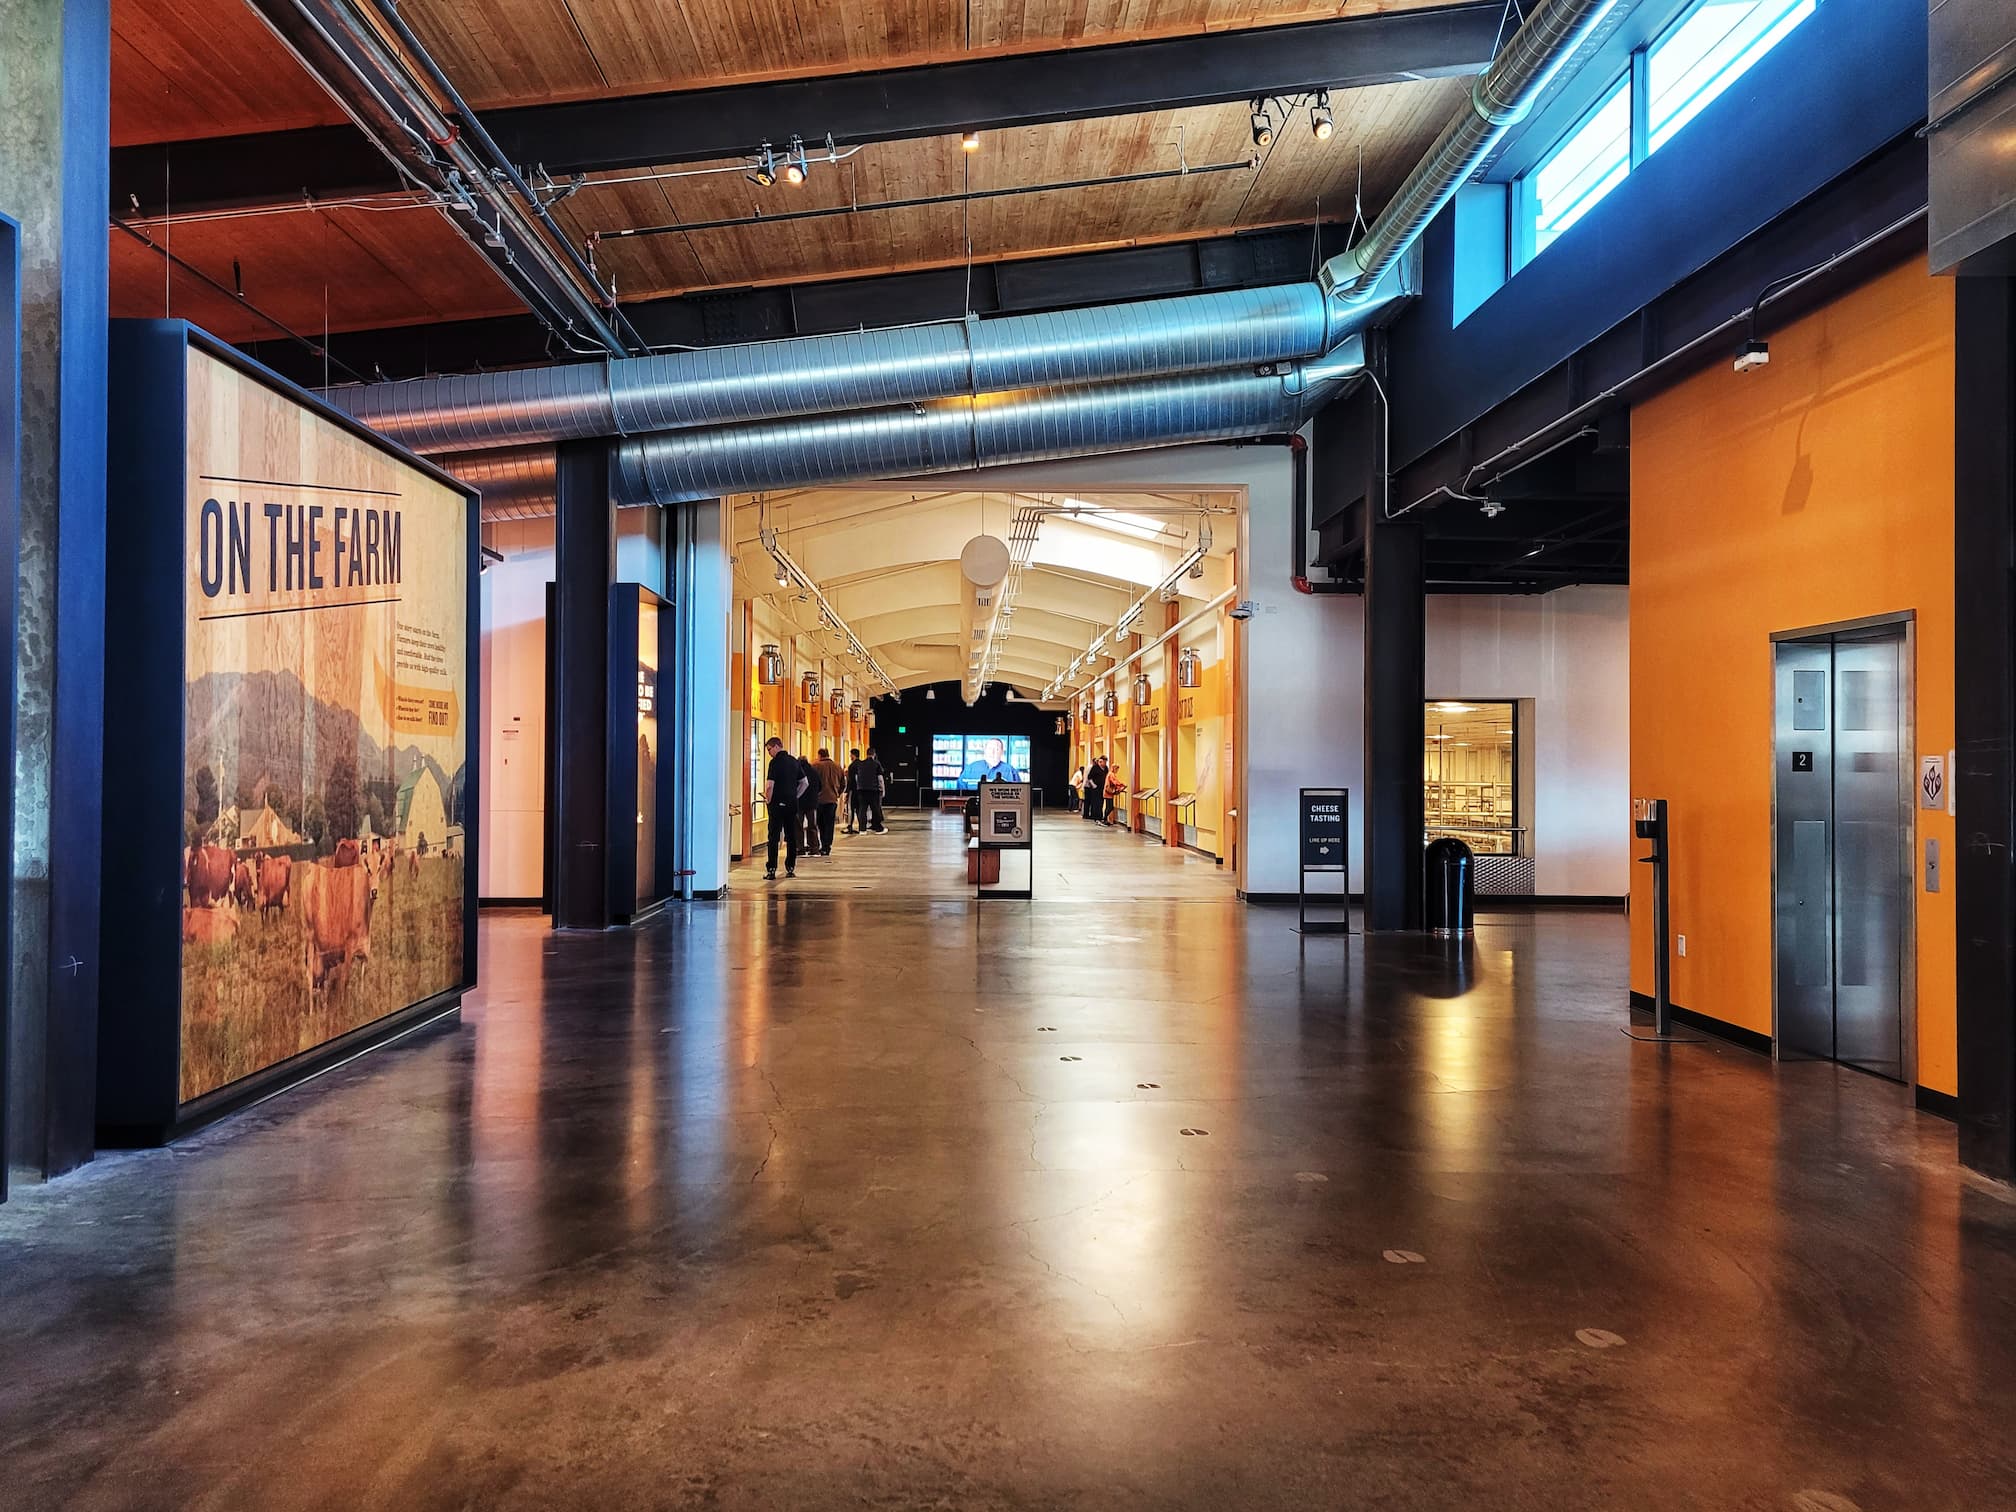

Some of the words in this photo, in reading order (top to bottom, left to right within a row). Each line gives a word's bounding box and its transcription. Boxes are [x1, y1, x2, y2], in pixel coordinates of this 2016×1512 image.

[200, 498, 251, 598] ON
[264, 503, 323, 592] THE
[334, 507, 401, 588] FARM
[429, 710, 438, 725] FIND
[1799, 754, 1806, 766] 2
[1311, 805, 1339, 813] CHEESE
